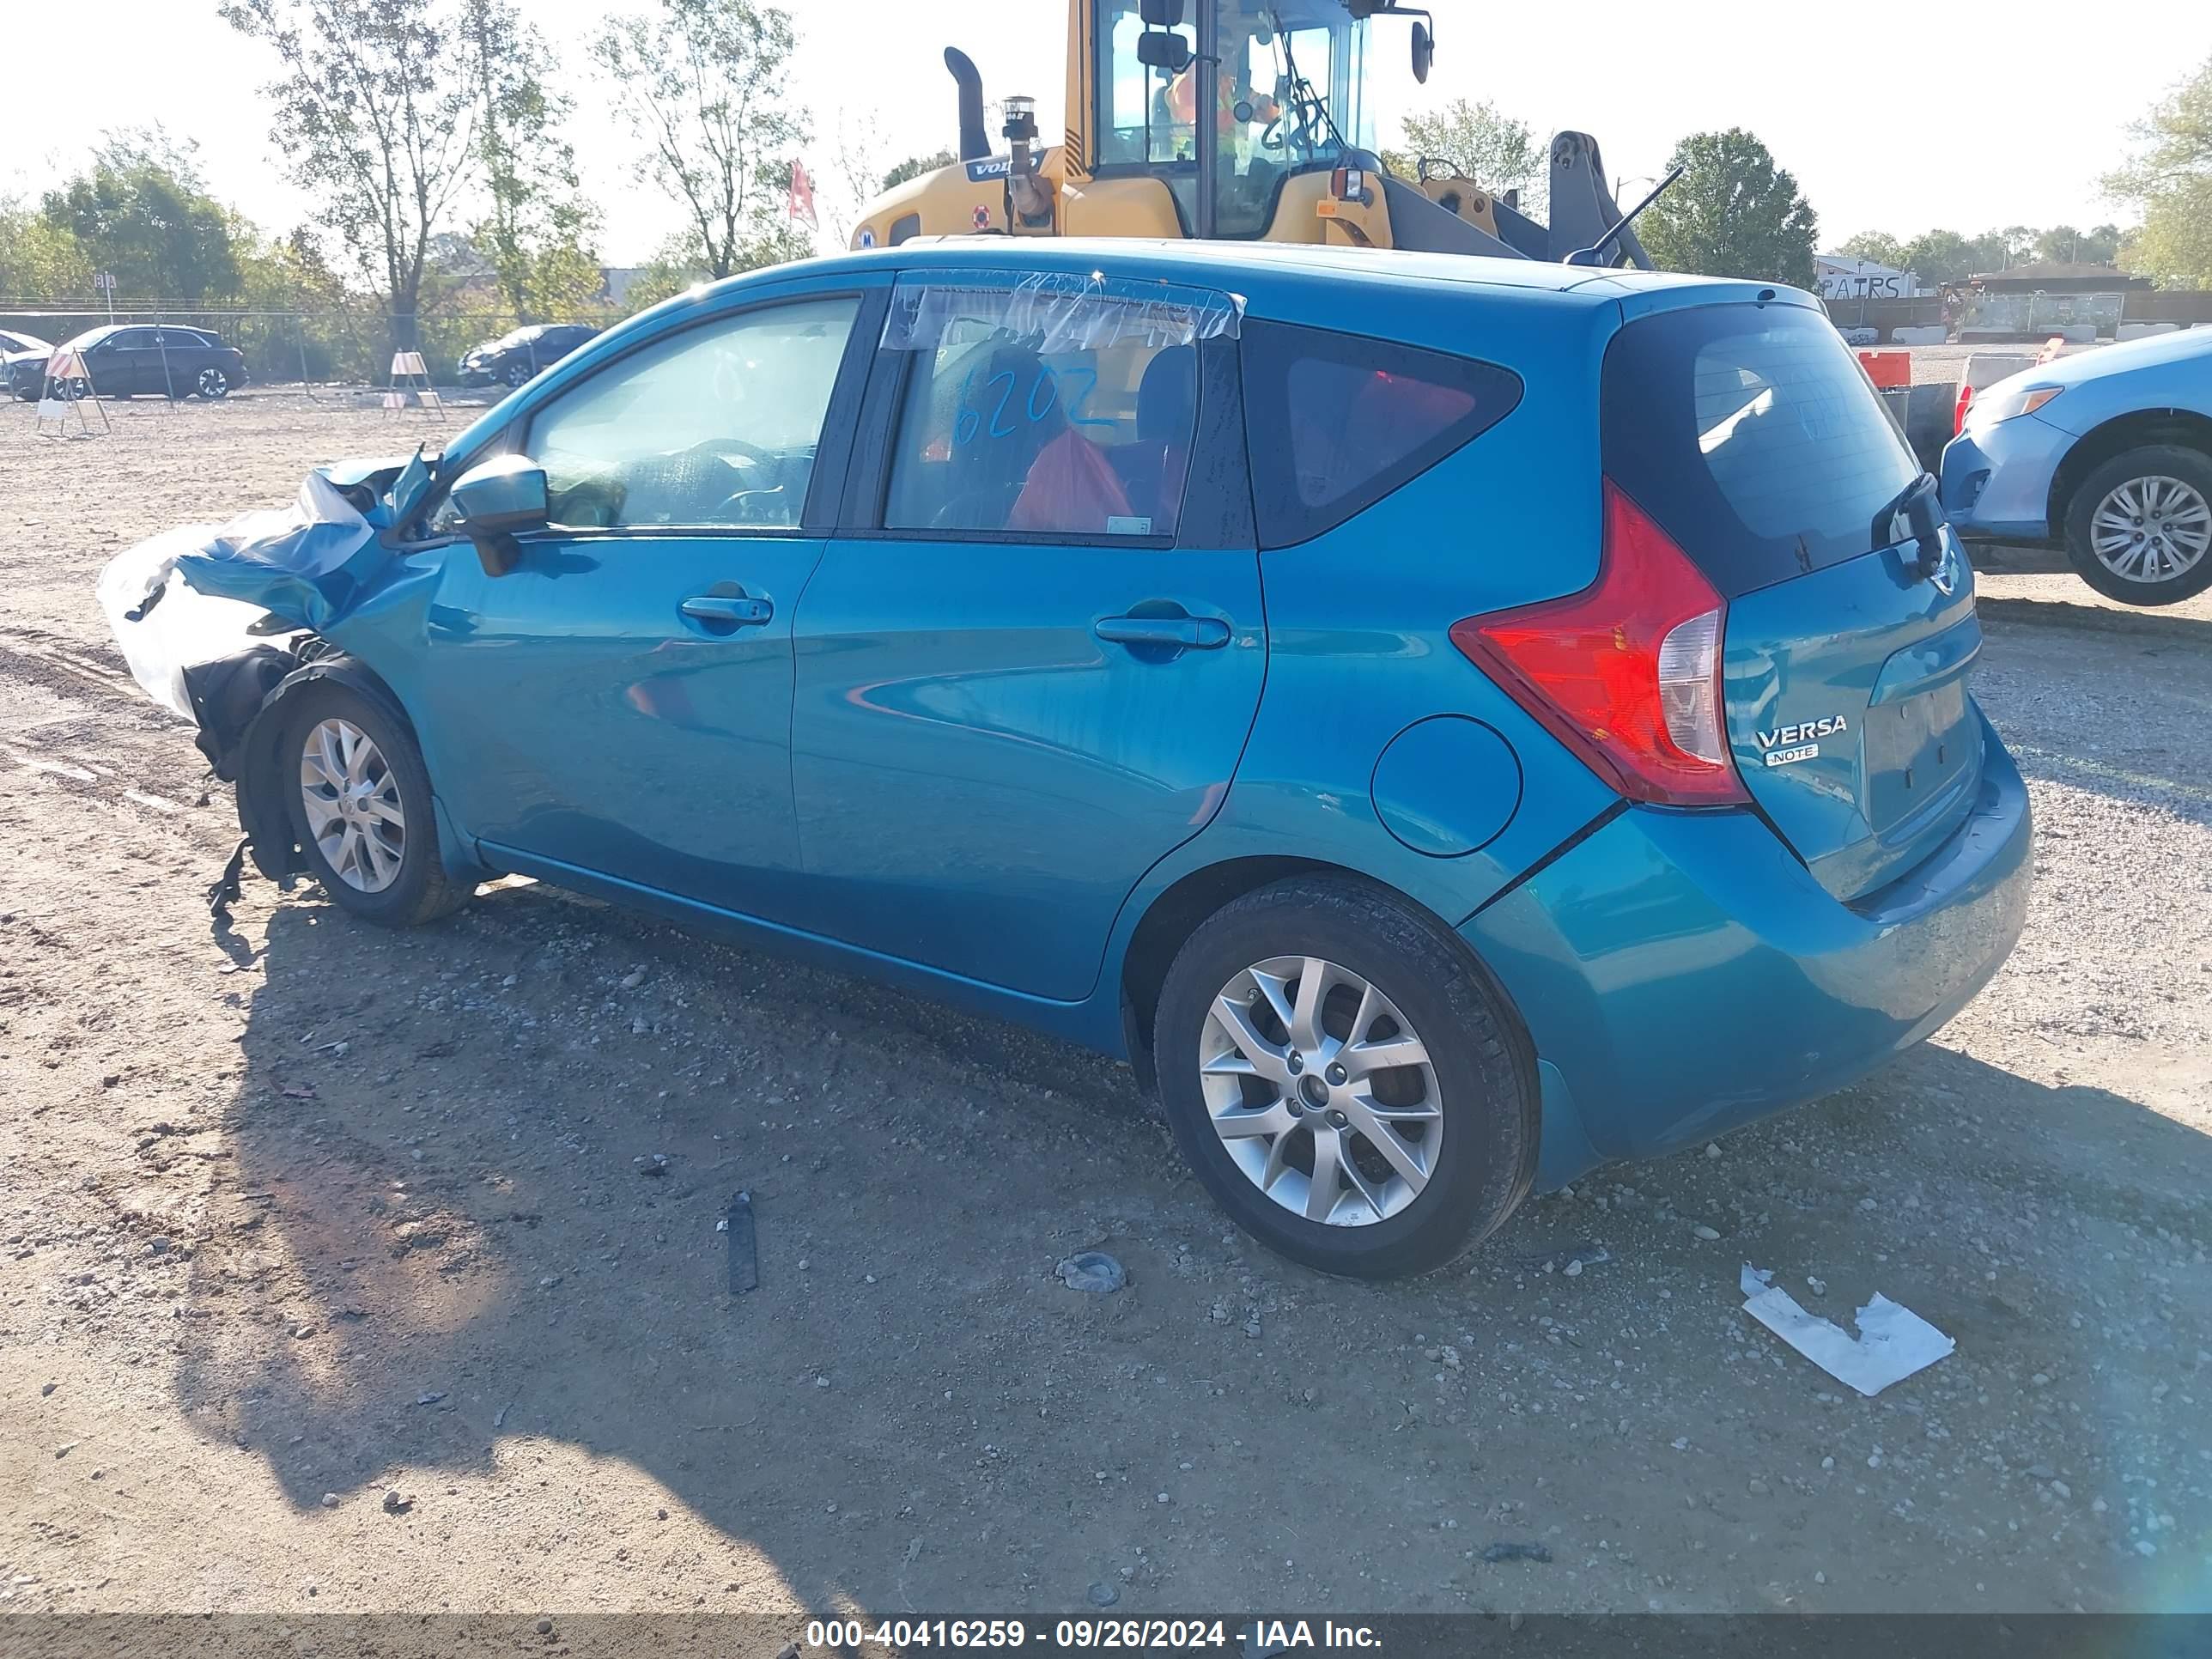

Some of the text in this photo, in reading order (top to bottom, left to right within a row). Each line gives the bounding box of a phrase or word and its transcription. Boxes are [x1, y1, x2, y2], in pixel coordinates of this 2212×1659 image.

[975, 156, 1038, 176] VOLO
[1756, 714, 1848, 749] VERSA
[1772, 745, 1814, 763] NOTE
